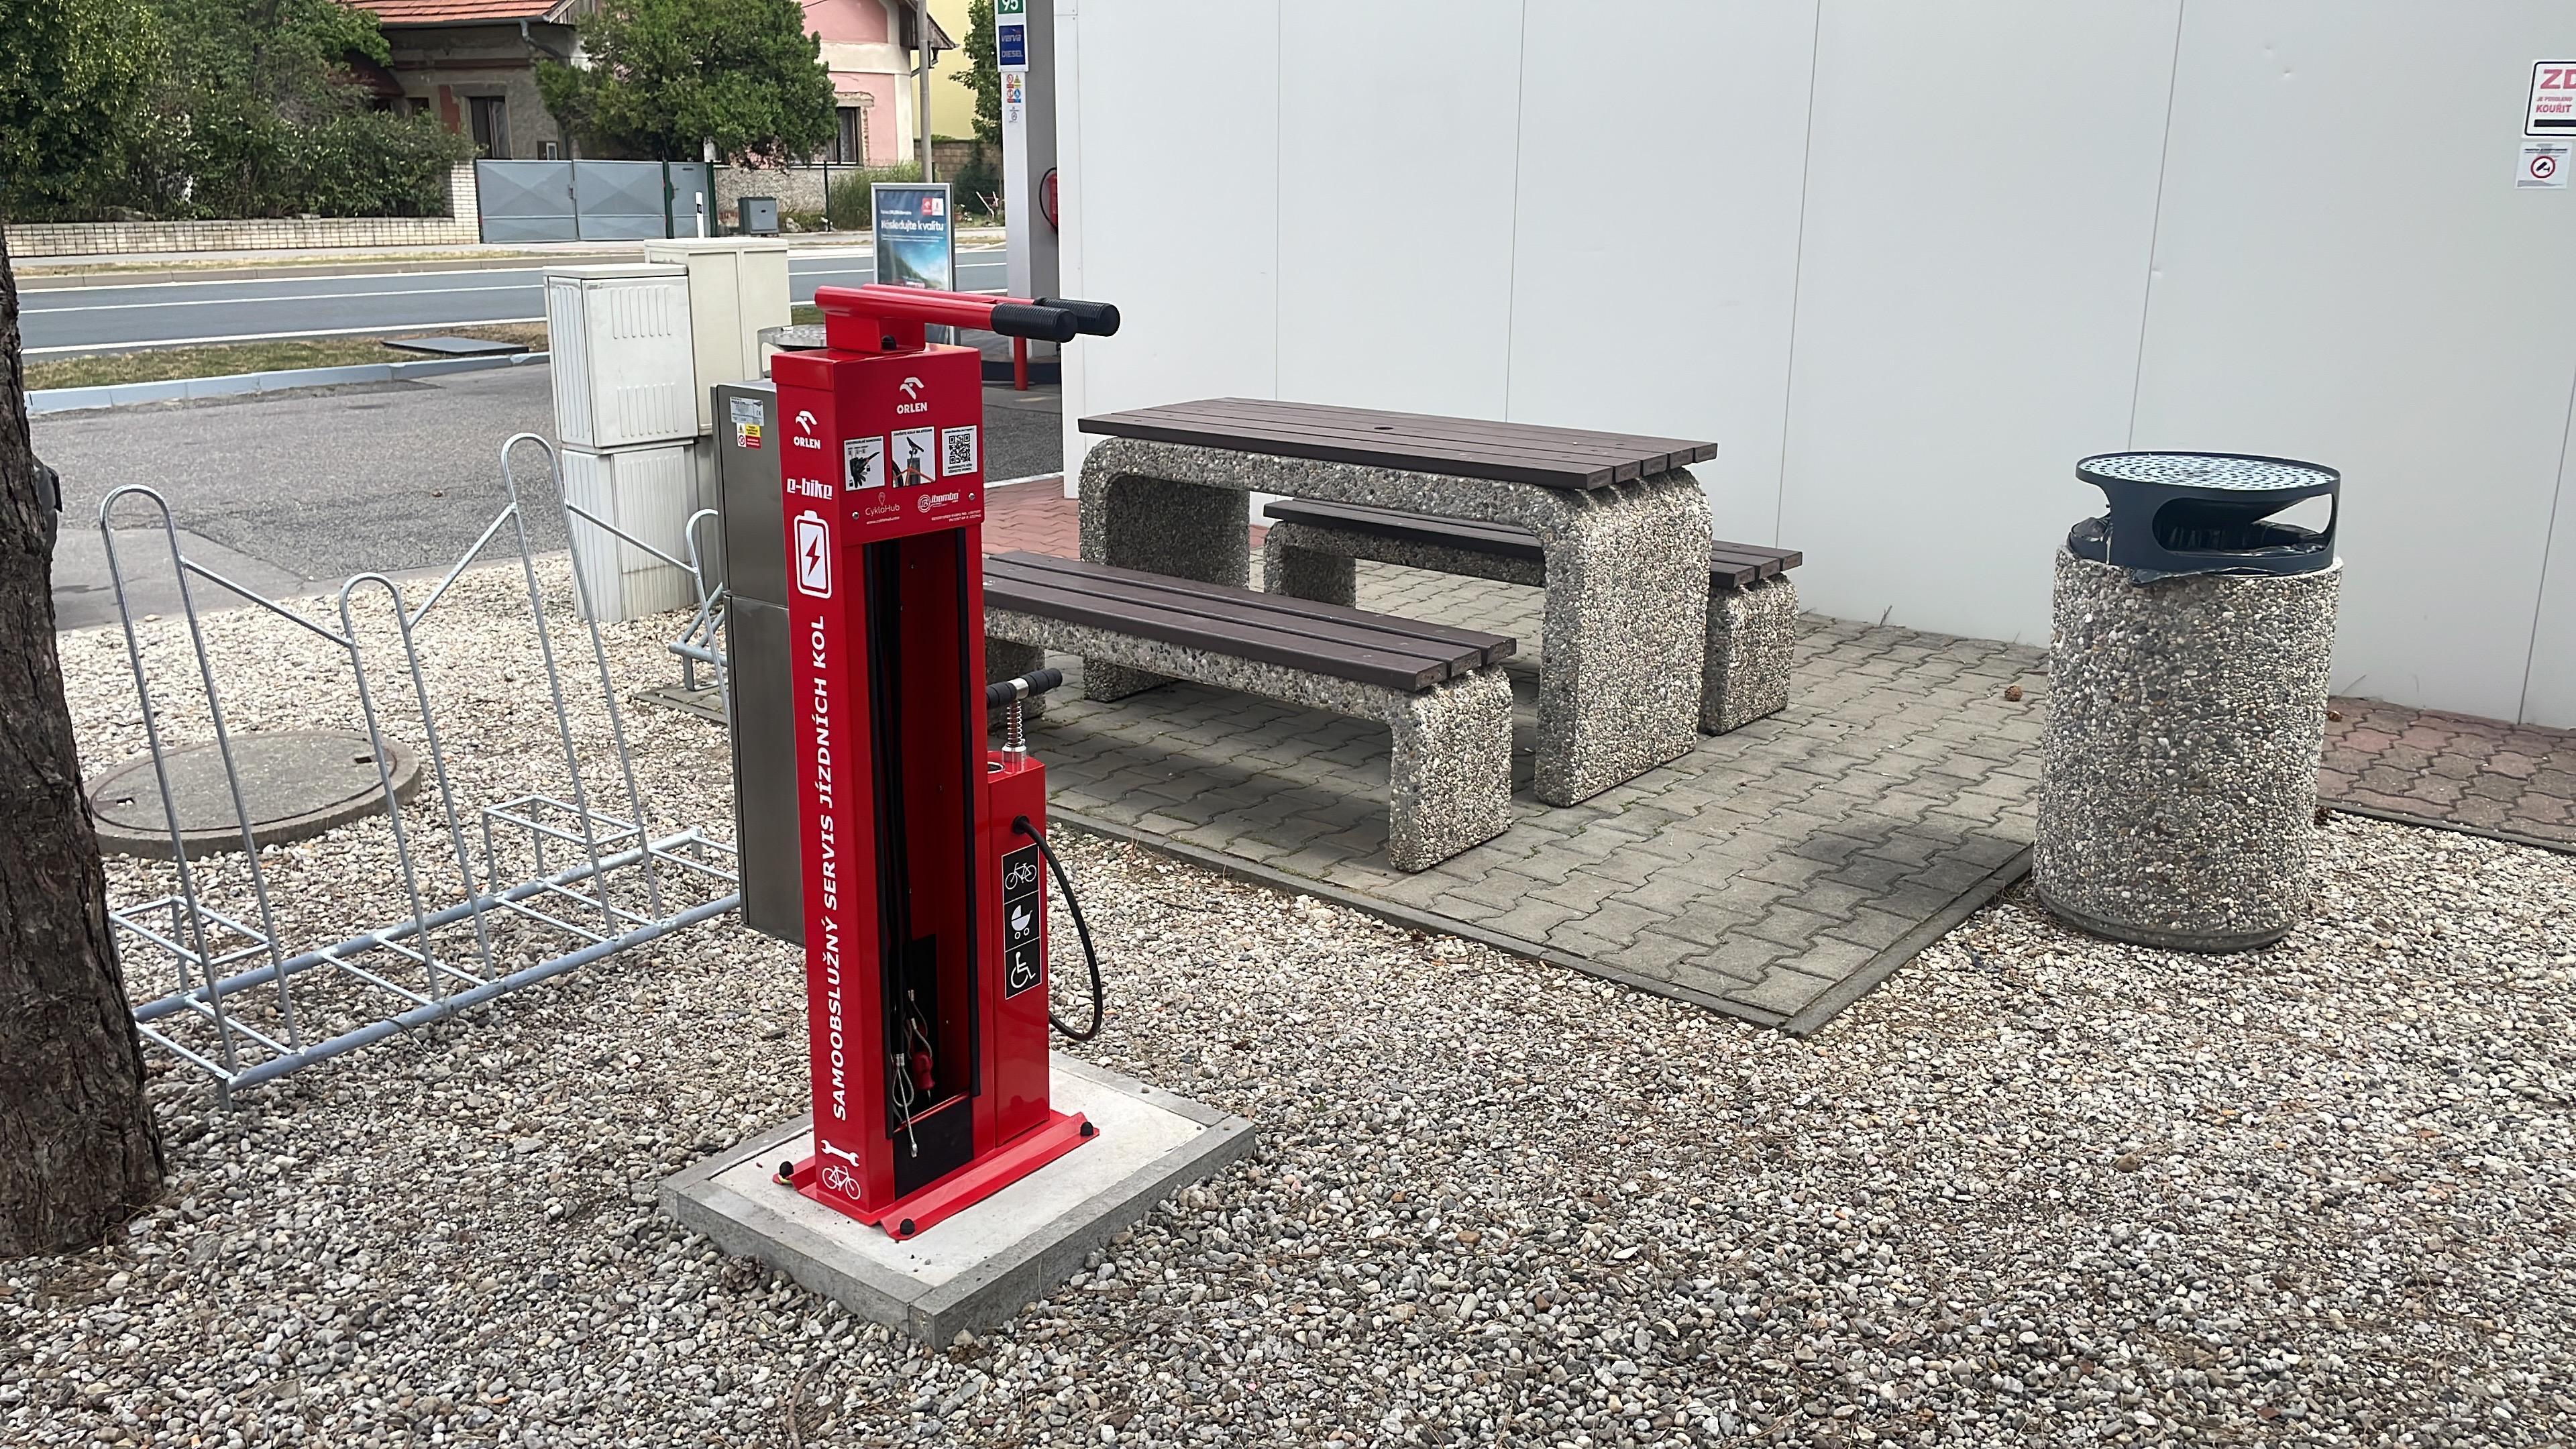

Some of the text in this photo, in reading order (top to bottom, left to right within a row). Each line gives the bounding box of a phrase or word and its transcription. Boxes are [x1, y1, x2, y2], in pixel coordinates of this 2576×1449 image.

[1002, 0, 1018, 11] 95
[1001, 34, 1022, 42] verva
[1001, 50, 1024, 58] DIESEL
[896, 402, 928, 415] ORLEN
[794, 436, 821, 449] ORLEN
[787, 478, 833, 500] e-bike
[865, 503, 900, 517] CykloHub
[810, 615, 847, 1121] SAMOOBSLUŽNÝ SERVIS JÍZDNÍCH KOL
